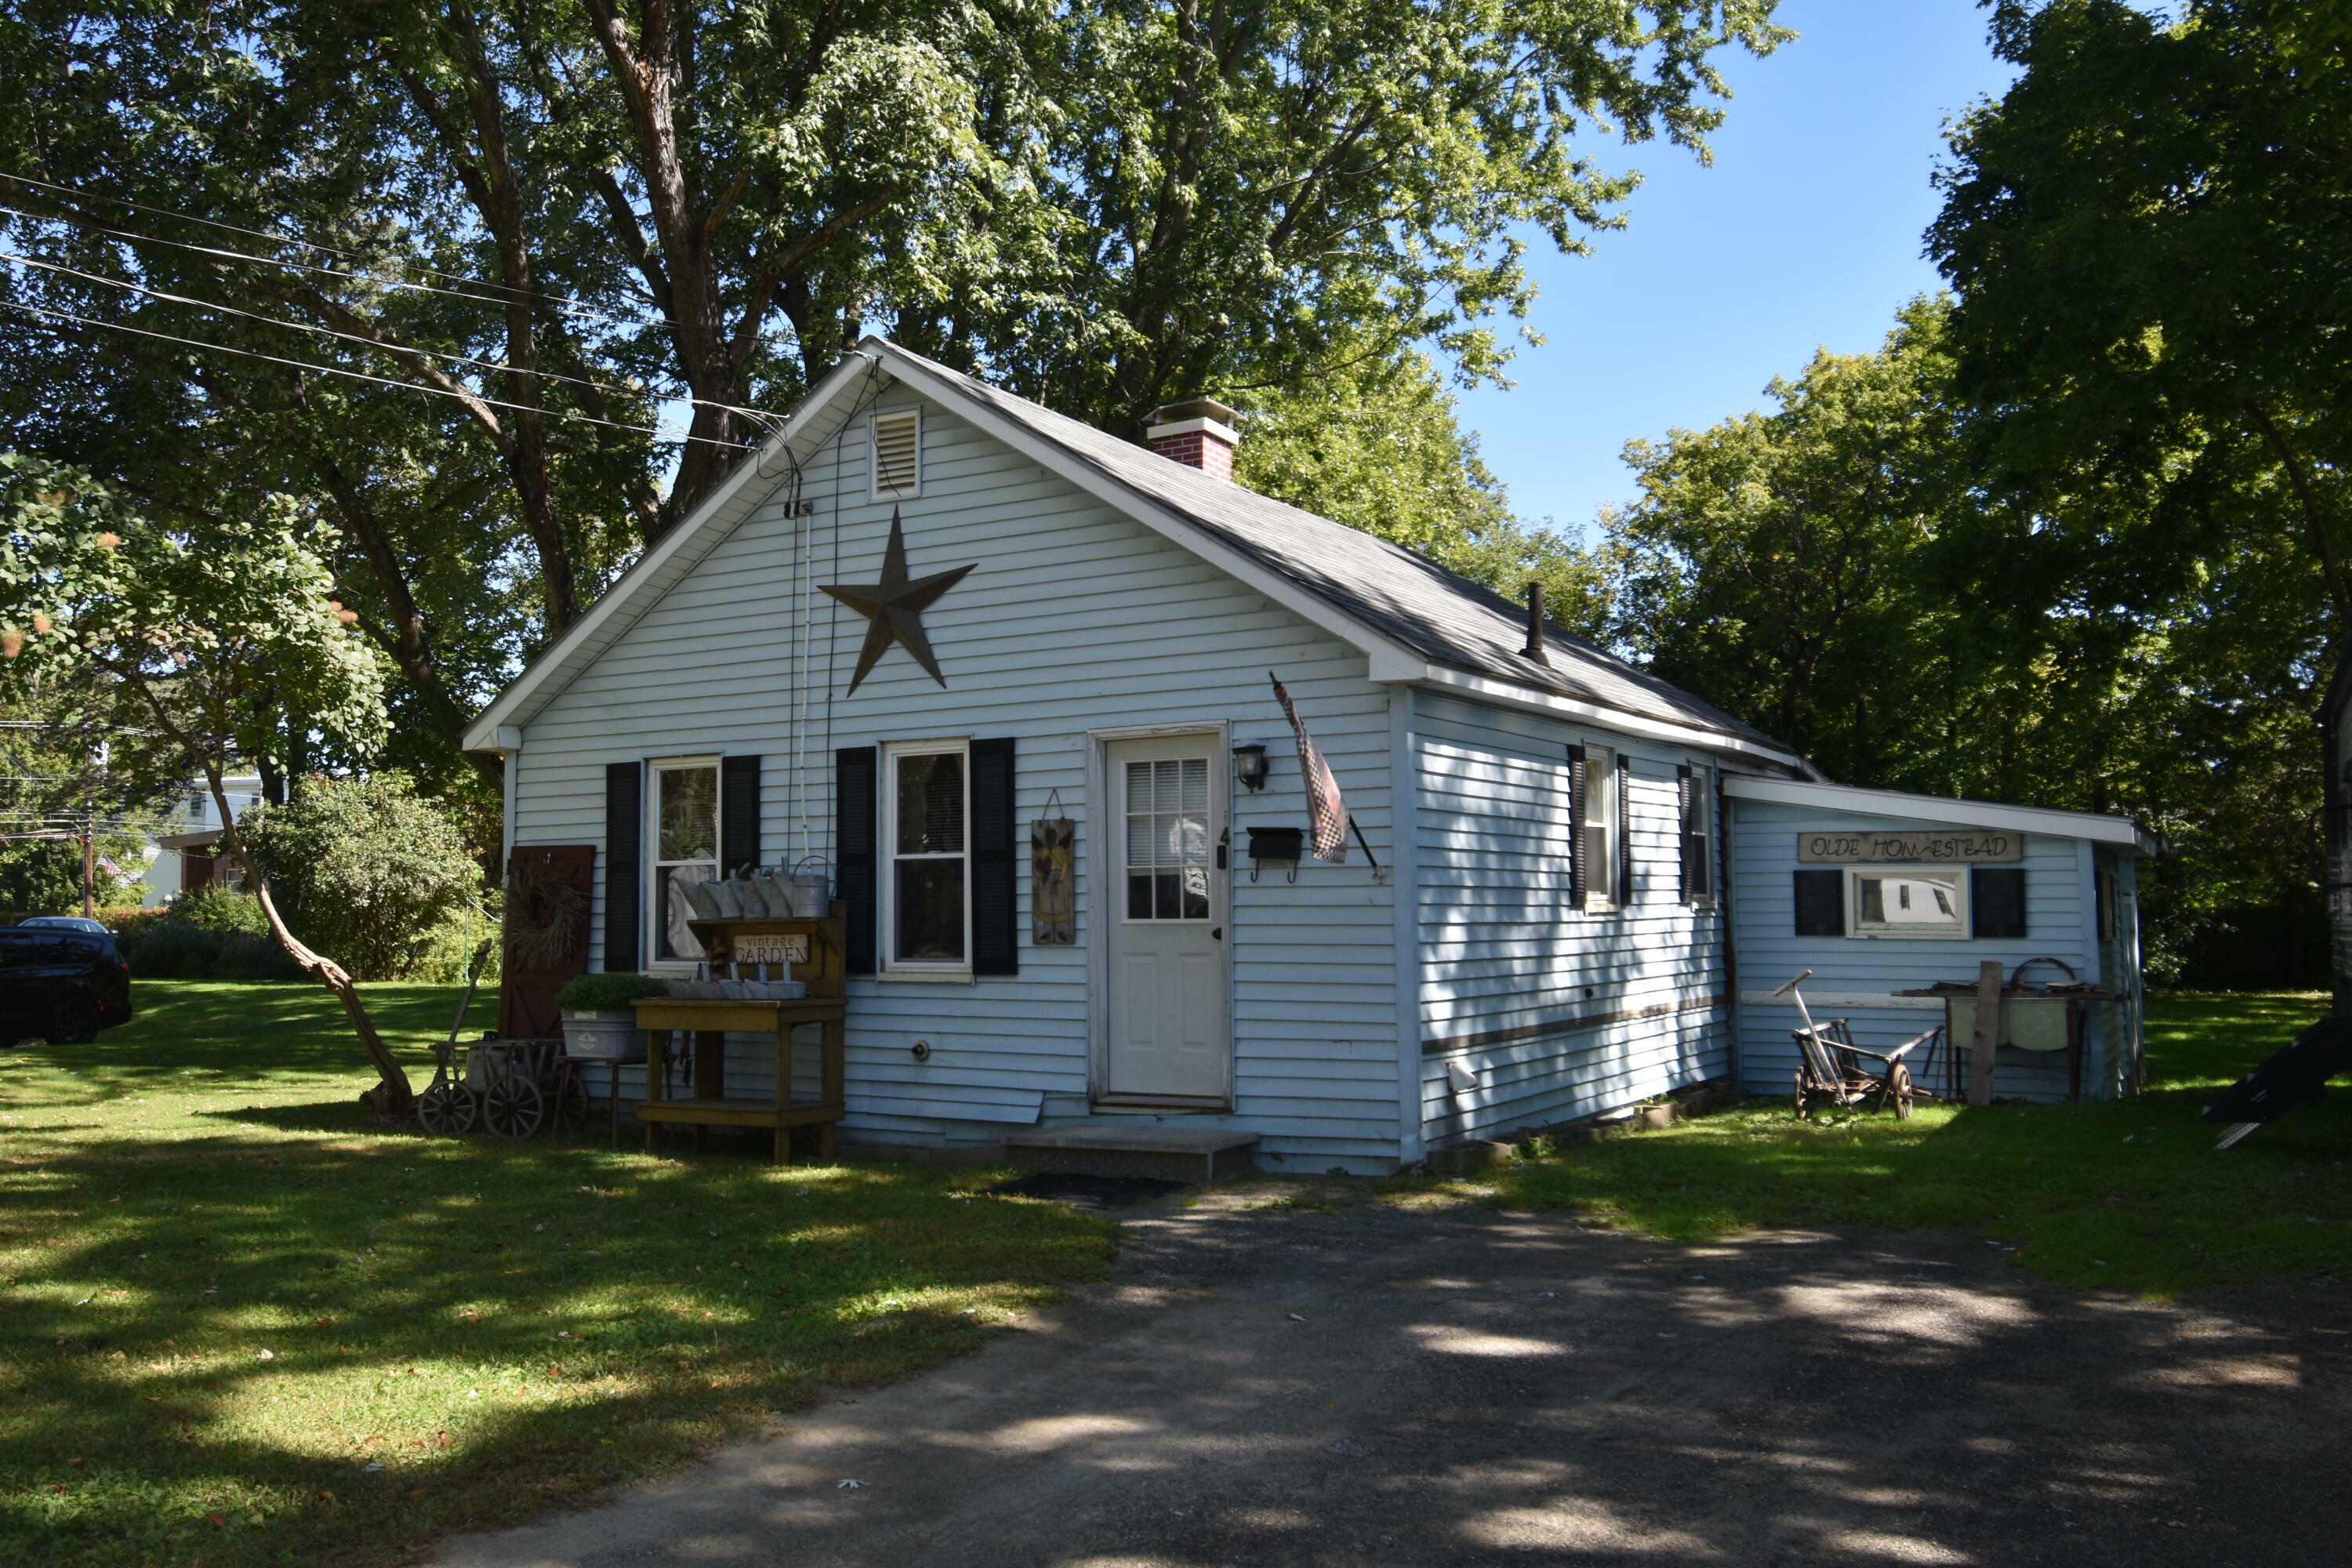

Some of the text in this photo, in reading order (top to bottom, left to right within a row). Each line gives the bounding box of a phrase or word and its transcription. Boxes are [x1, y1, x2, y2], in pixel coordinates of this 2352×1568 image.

[1220, 826, 1230, 845] 4
[1811, 837, 2007, 857] OLDE HOMESTEAD
[746, 936, 794, 949] vintage
[735, 946, 807, 964] GARDEN
